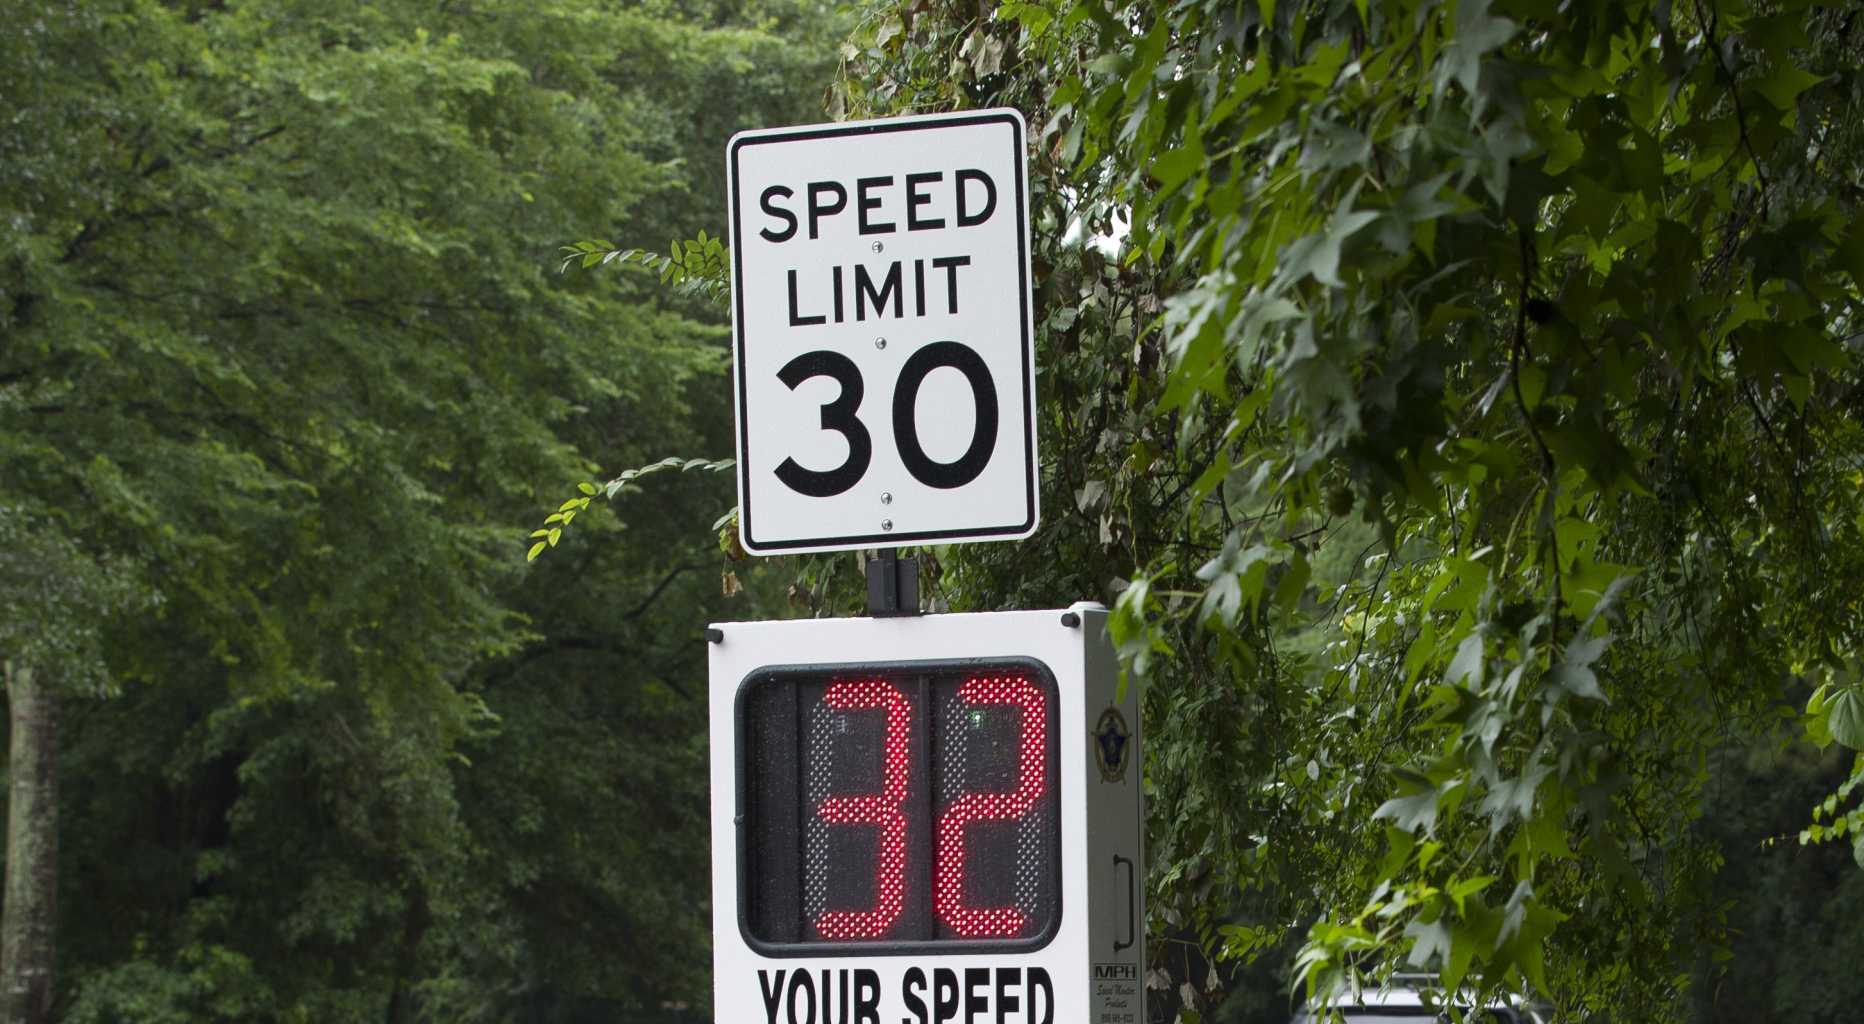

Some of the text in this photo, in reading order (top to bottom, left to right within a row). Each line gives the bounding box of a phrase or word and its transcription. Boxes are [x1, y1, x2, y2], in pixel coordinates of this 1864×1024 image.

[759, 168, 998, 243] SPEED
[787, 255, 971, 327] LIMIT
[773, 341, 999, 497] 30
[815, 676, 1046, 938] 32
[1095, 965, 1136, 978] MPH
